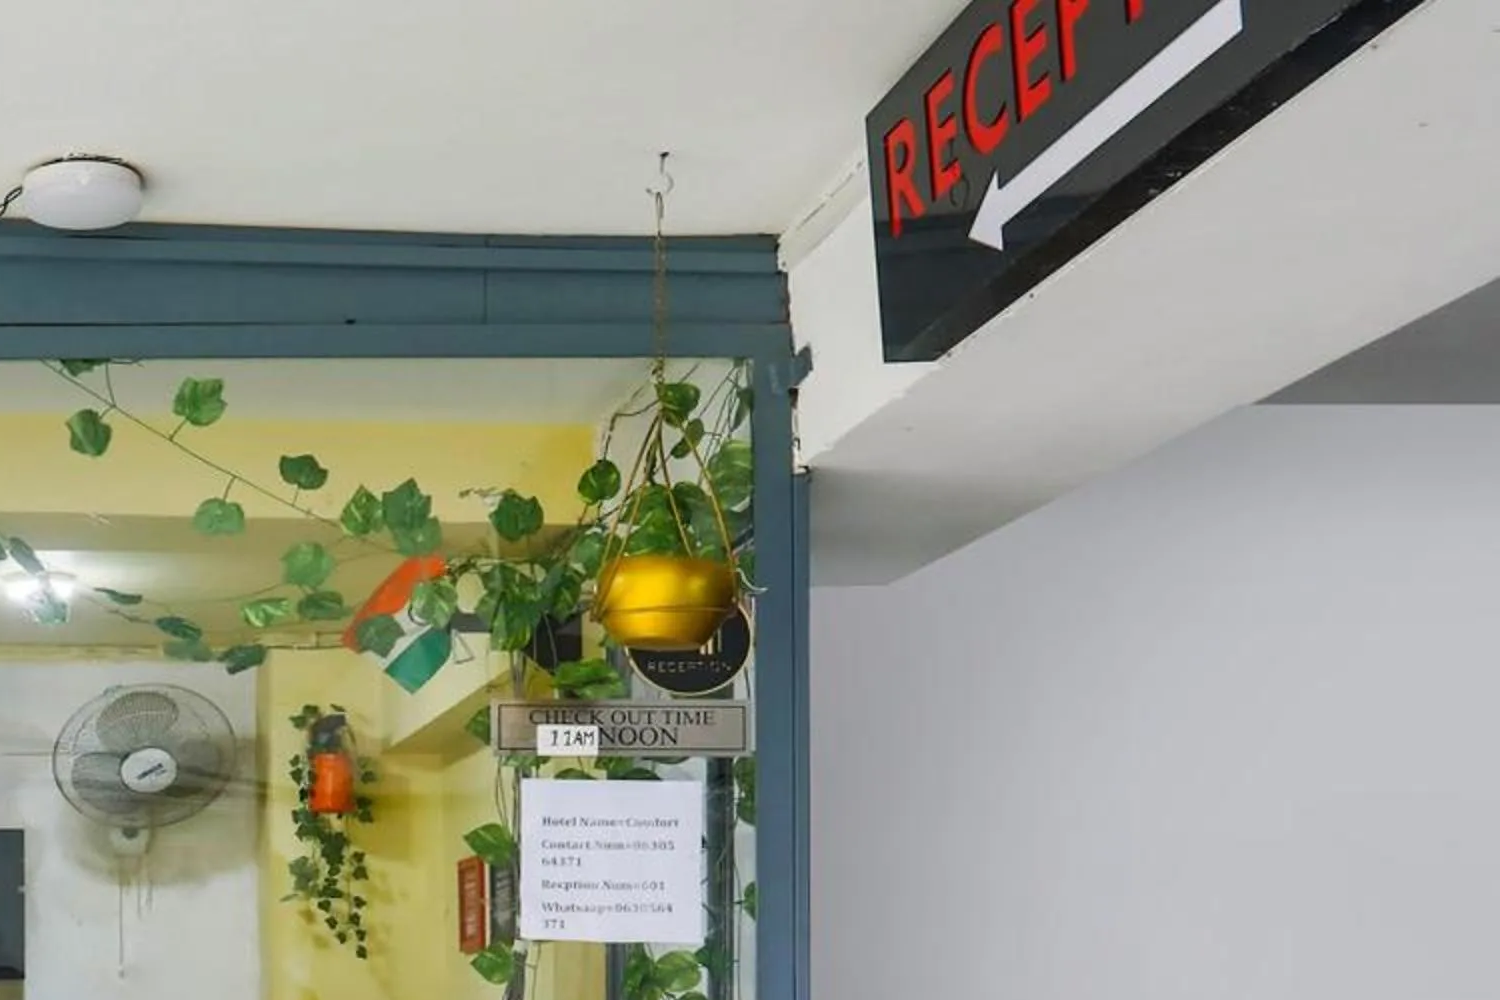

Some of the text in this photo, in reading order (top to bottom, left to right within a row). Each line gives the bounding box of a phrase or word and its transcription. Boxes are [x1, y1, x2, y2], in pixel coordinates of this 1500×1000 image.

[884, 0, 1146, 239] RECEP
[529, 710, 716, 726] CHECK OUT TIME
[599, 727, 679, 747] NOON
[541, 815, 577, 828] Hotel
